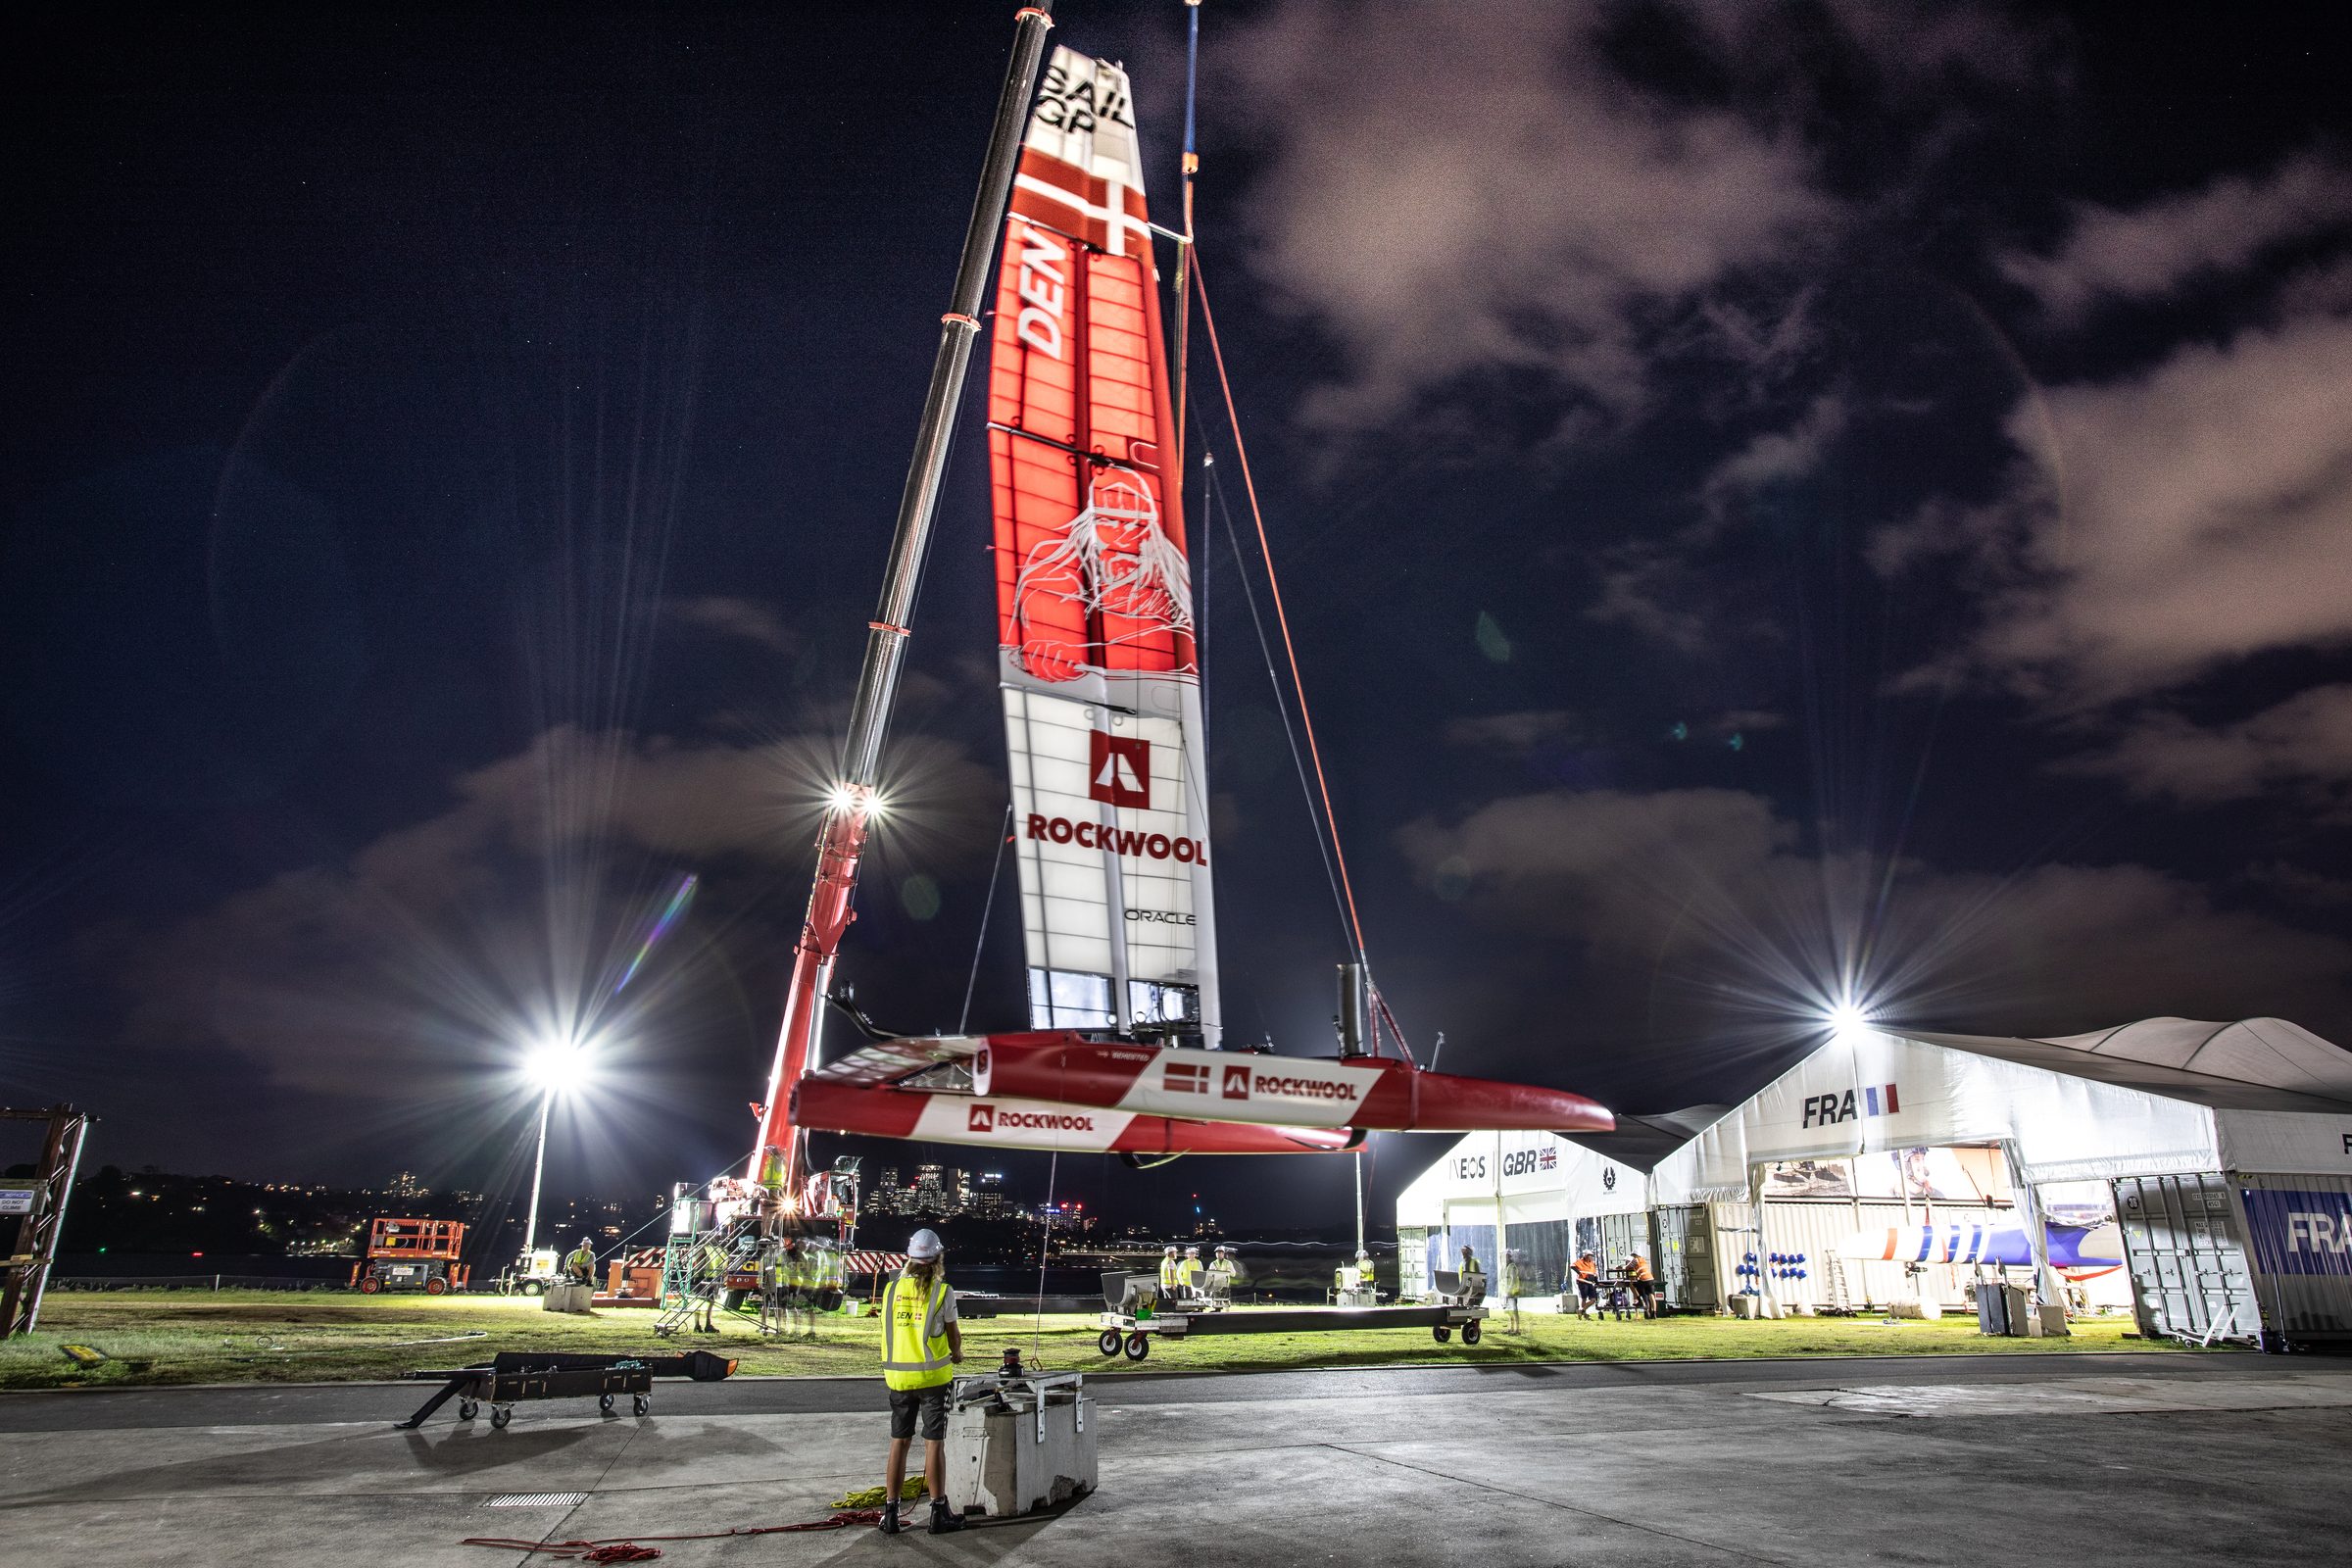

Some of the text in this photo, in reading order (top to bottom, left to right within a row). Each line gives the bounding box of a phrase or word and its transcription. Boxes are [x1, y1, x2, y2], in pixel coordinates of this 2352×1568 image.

[1036, 95, 1097, 134] GP
[1042, 65, 1134, 130] SAIL
[1017, 228, 1065, 360] DEN
[1027, 813, 1207, 867] ROCKWOOL
[1124, 908, 1197, 926] ORACLE
[1255, 1076, 1357, 1101] ROCKWOOL
[998, 1111, 1094, 1132] ROCKWOOL
[1803, 1089, 1858, 1129] FRA
[1449, 1150, 1537, 1180] INEOS GBR
[2288, 1212, 2352, 1252] FRA
